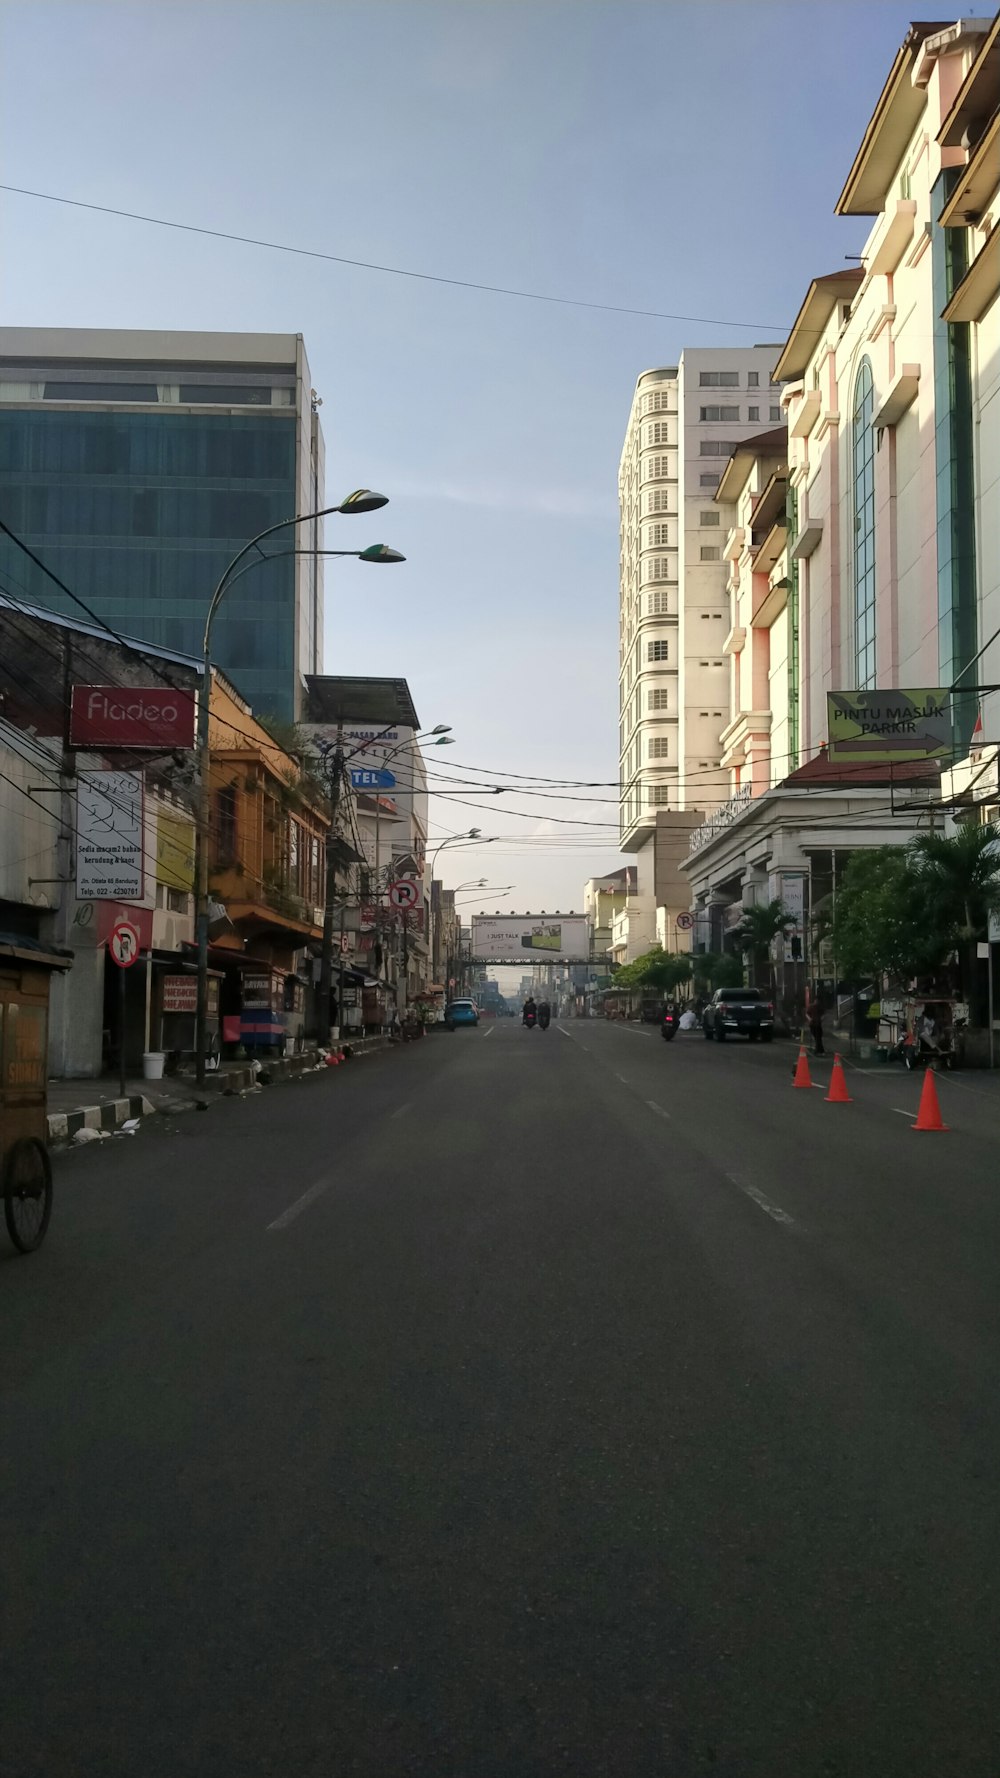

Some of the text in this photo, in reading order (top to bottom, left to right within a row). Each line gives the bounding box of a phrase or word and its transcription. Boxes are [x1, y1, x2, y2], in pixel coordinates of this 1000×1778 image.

[834, 707, 944, 721] PINTU MASUK
[862, 722, 917, 735] PARKIR
[352, 771, 379, 784] TEL
[81, 779, 141, 796] TOKO
[78, 845, 96, 853] Sedia
[84, 856, 114, 865] kerudung
[115, 878, 139, 886] Bandung
